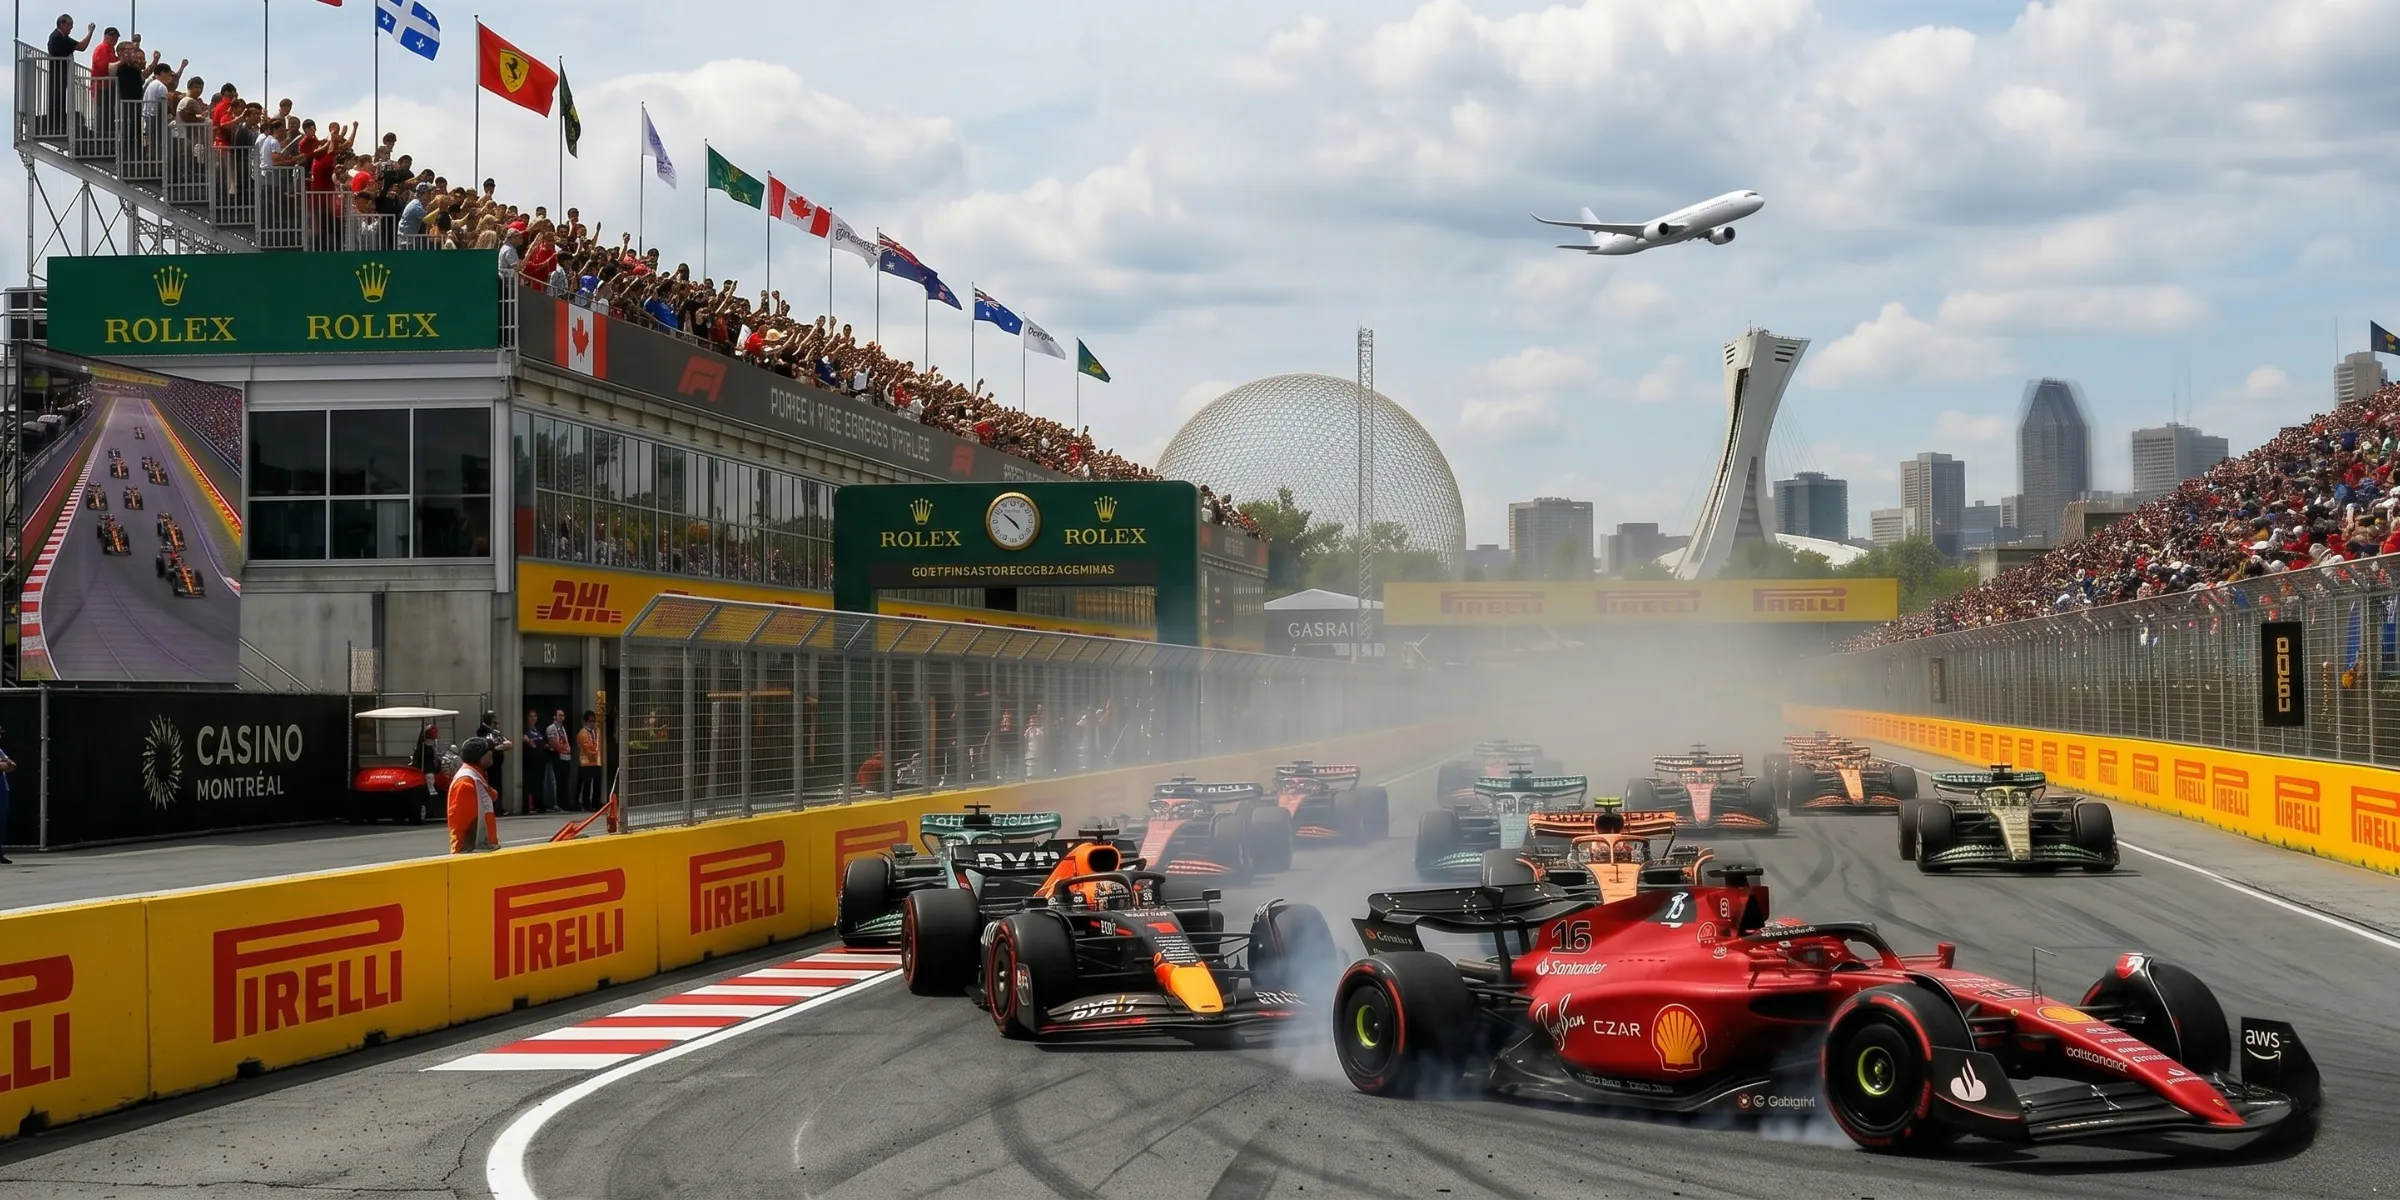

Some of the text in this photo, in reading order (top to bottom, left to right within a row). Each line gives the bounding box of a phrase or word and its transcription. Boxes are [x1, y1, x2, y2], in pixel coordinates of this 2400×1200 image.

[104, 316, 237, 343] ROLEX
[306, 312, 440, 340] ROLEX
[880, 531, 962, 548] ROLEX
[1064, 528, 1147, 545] ROLEX
[549, 579, 612, 623] DHL
[197, 723, 303, 766] CASINO
[197, 769, 285, 801] MONTRÉAL
[2174, 758, 2206, 806] PIRELLI
[2212, 765, 2249, 818] PIRELLI
[2274, 774, 2321, 836] PIRELLI
[2351, 785, 2400, 854] PIRELL
[689, 839, 786, 936] PIRELLI
[494, 867, 627, 981] PIRELLI
[1550, 919, 1593, 955] 16
[213, 903, 405, 1045] PIRELLI
[1549, 960, 1607, 976] Santander
[1593, 1020, 1641, 1038] CZAR
[2245, 1029, 2280, 1048] aws
